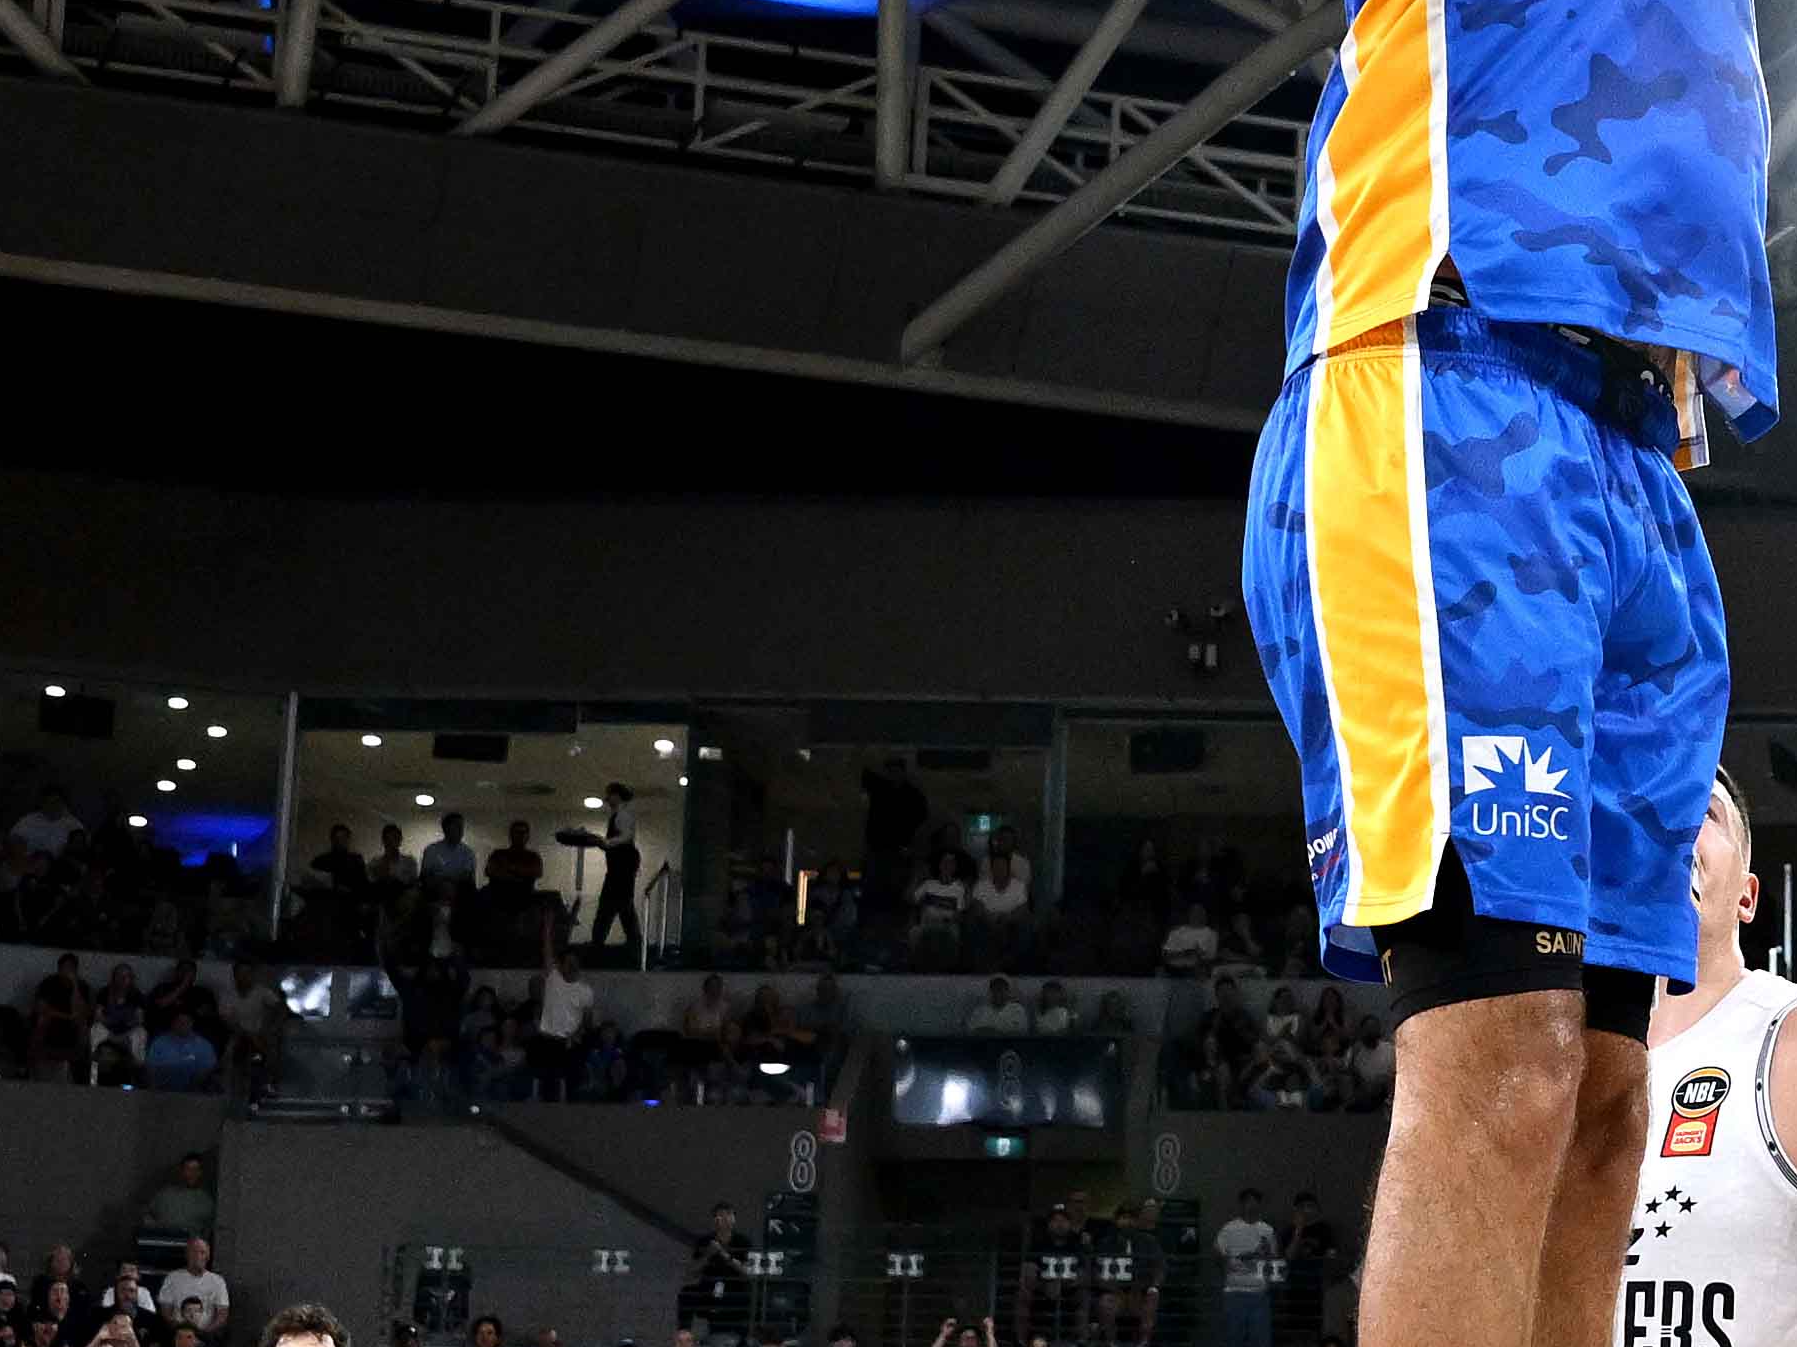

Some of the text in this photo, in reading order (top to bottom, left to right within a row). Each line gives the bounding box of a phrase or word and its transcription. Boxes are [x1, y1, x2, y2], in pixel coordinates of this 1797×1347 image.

[1472, 802, 1569, 841] UniSC
[1683, 1081, 1717, 1104] NBL
[789, 1130, 816, 1192] 8
[1154, 1132, 1181, 1194] 8
